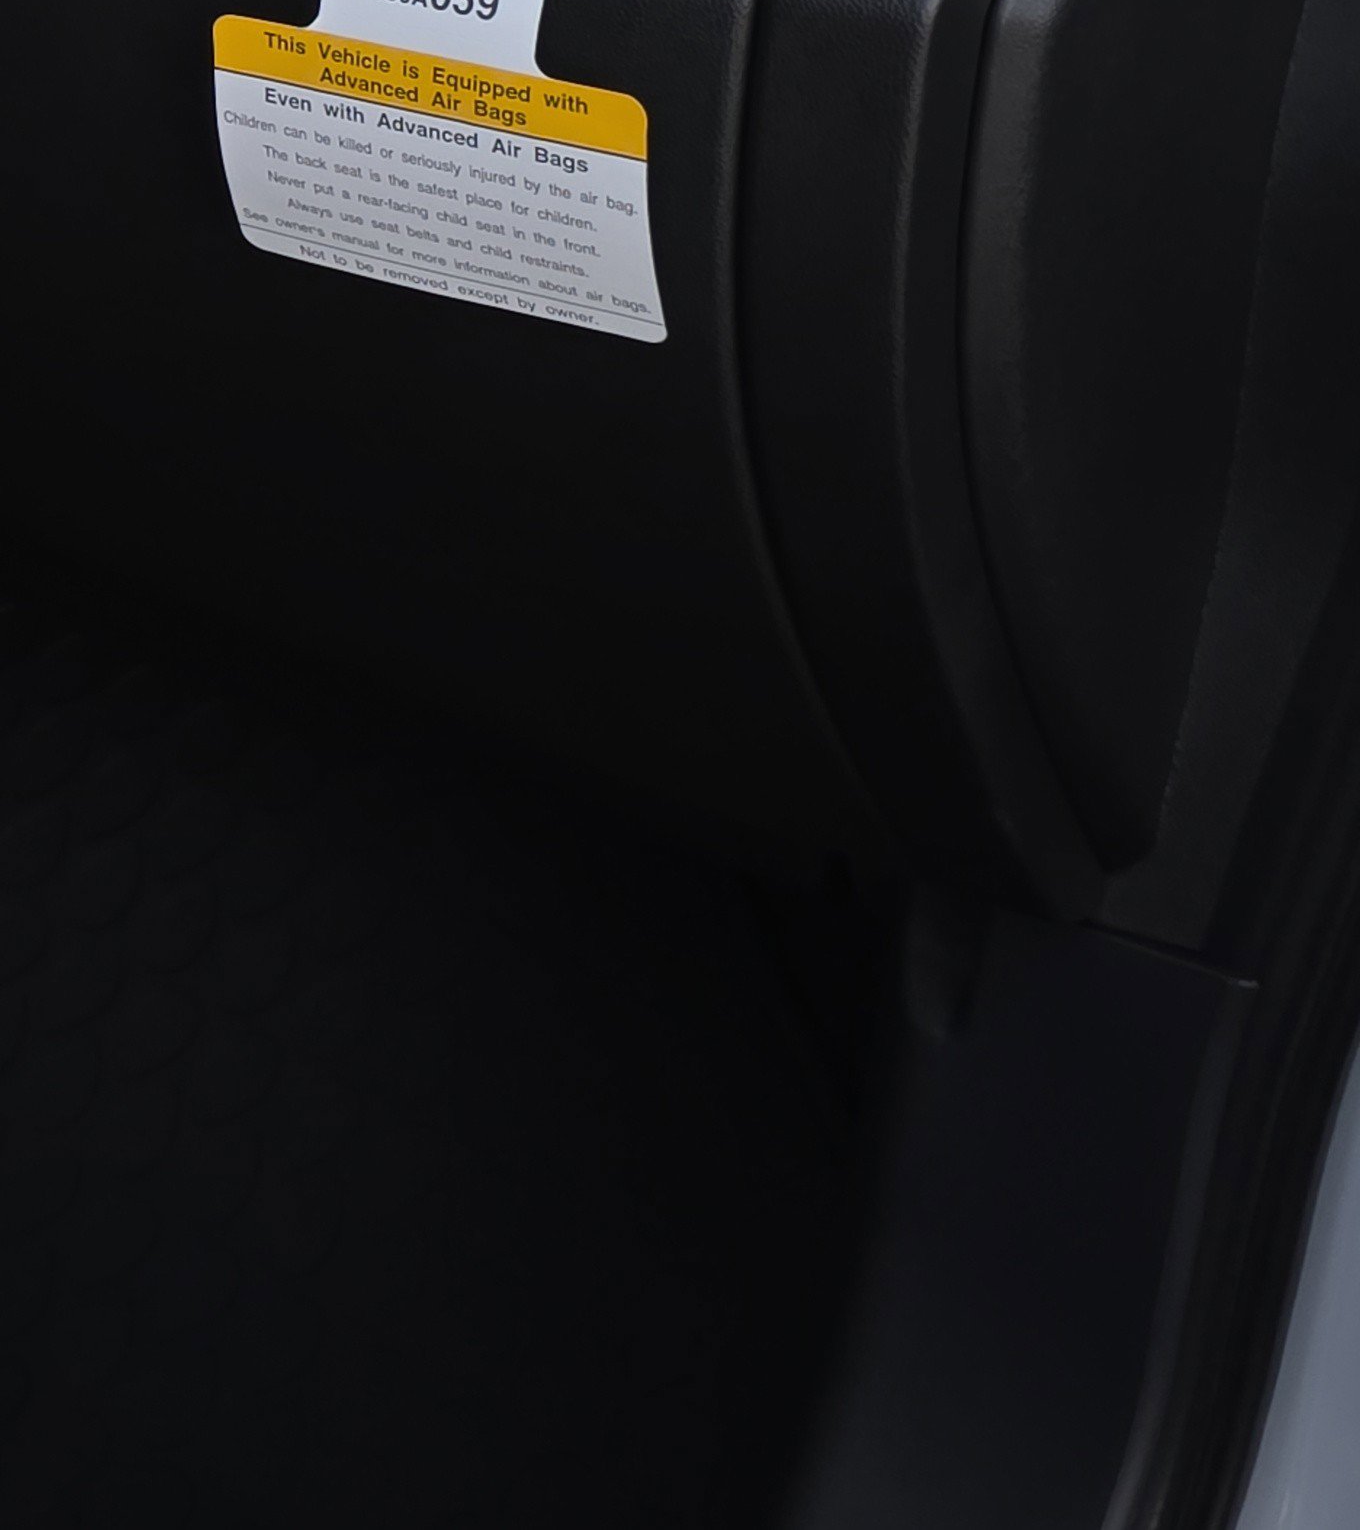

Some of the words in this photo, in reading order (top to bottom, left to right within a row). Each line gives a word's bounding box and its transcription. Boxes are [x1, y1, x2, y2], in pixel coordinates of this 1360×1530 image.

[264, 31, 306, 54] This
[318, 42, 391, 73] Vehicle
[402, 60, 419, 79] is
[432, 67, 531, 102] Equipped
[544, 93, 588, 114] with
[320, 67, 419, 103] Advanced
[432, 92, 461, 111] Air
[474, 100, 526, 126] Bags
[223, 110, 277, 133] Children
[284, 126, 307, 140] can
[314, 131, 330, 145] be
[338, 137, 372, 155] killed
[380, 148, 394, 159] or
[401, 151, 461, 176] seriously
[469, 165, 516, 187] injured
[524, 177, 541, 195] by
[549, 184, 571, 199] the
[580, 191, 598, 205] air
[606, 196, 638, 216] bag.
[265, 87, 312, 112] Even
[324, 103, 365, 124] with
[377, 114, 478, 148] Advanced
[492, 139, 521, 158] Air
[535, 147, 589, 174] Bags
[262, 145, 288, 161] The
[295, 152, 327, 170] back
[334, 162, 362, 178] seat
[369, 169, 381, 182] is
[388, 174, 409, 189] the
[417, 181, 458, 200] safest
[466, 193, 502, 210] place
[511, 200, 529, 216] for
[537, 208, 598, 232] children.
[268, 170, 306, 189] Never
[314, 183, 334, 198] put
[342, 189, 351, 199] a
[358, 193, 428, 220] rear-facing
[436, 212, 468, 227] child
[476, 219, 505, 235] seat
[513, 226, 526, 240] in
[534, 231, 555, 247] the
[564, 238, 601, 257] front.
[243, 207, 269, 223] See
[331, 230, 379, 251] manual
[387, 242, 403, 256] for
[412, 249, 447, 267] more
[454, 257, 530, 285] information
[538, 278, 577, 297] about
[586, 289, 603, 303] air
[612, 295, 652, 314] bags.
[287, 198, 333, 219] Always
[340, 211, 363, 225] use
[372, 218, 399, 235] seat
[406, 224, 439, 243] belts
[447, 235, 472, 251] and
[480, 243, 512, 260] child
[520, 253, 590, 277] restraints.
[299, 245, 326, 260] Not
[333, 254, 347, 266] to
[356, 260, 374, 273] be
[383, 266, 448, 292] removed
[458, 284, 509, 306] except
[517, 295, 536, 312] by
[545, 305, 599, 325] owner.
